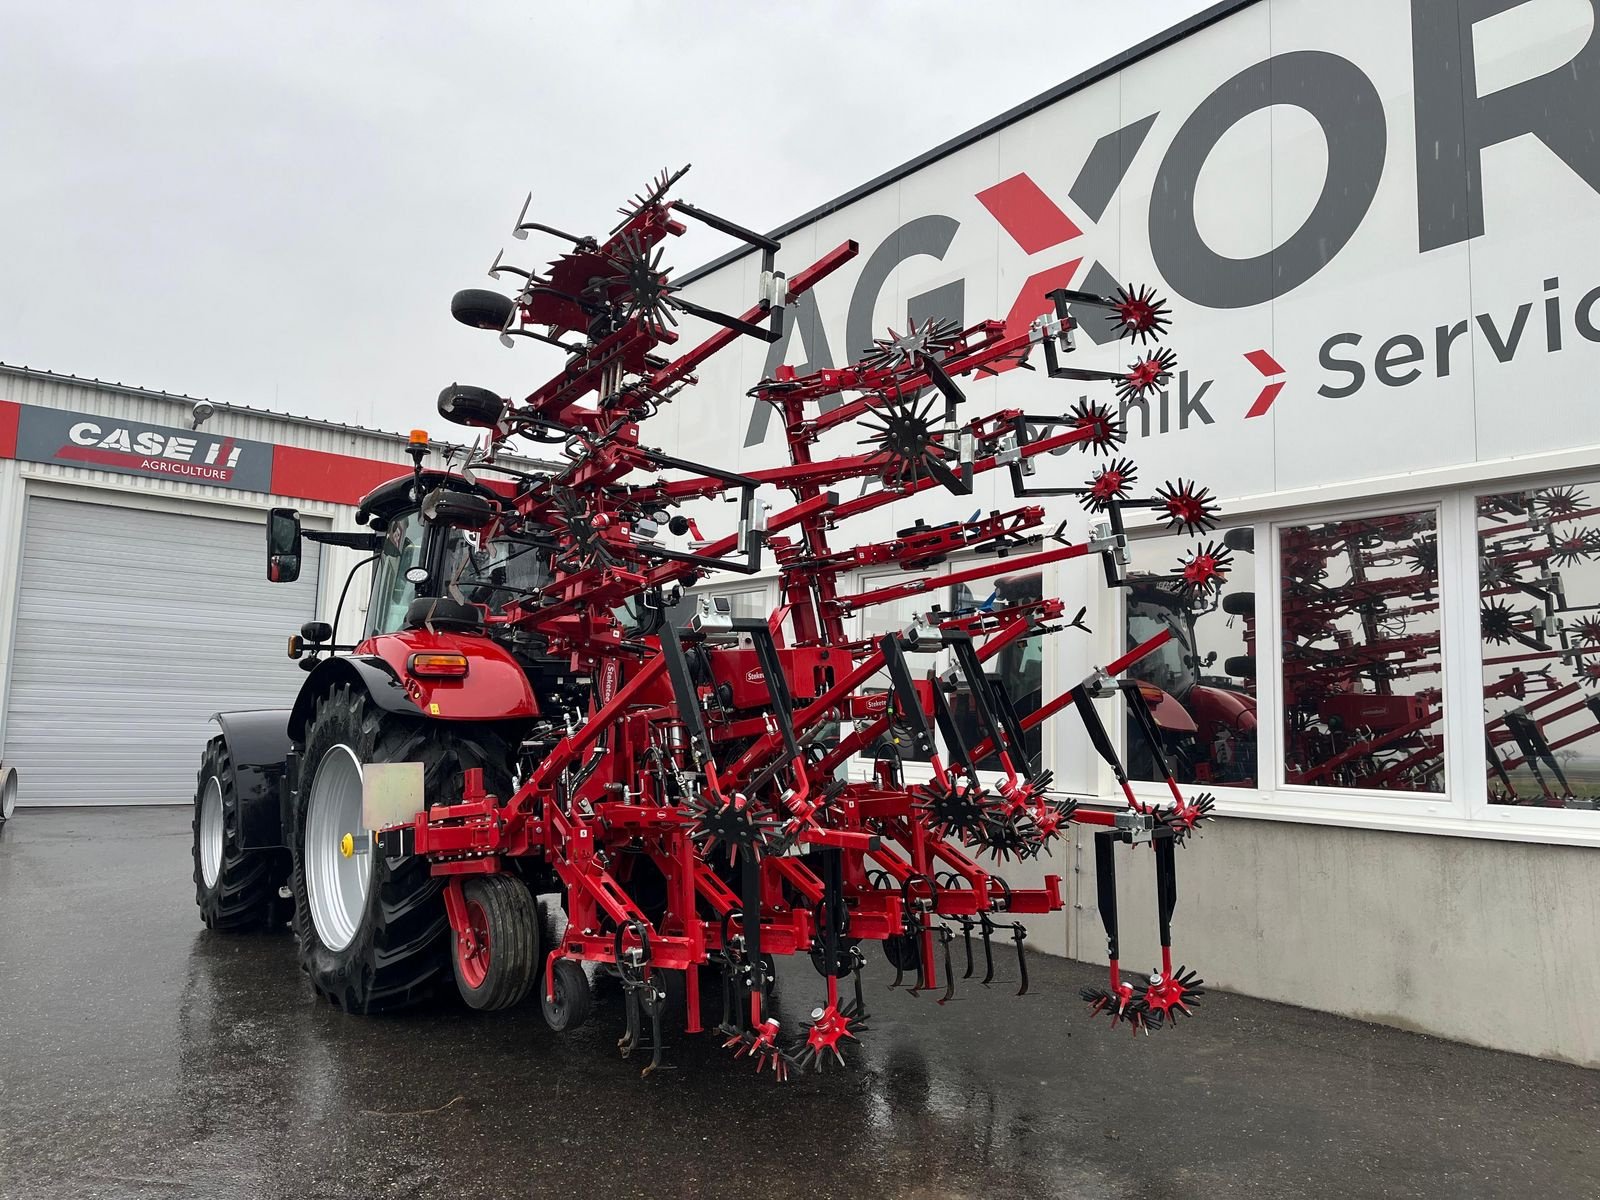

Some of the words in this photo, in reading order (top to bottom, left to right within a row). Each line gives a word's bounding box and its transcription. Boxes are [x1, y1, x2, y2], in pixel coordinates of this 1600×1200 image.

[69, 422, 198, 461] CASE
[141, 459, 227, 480] AGRICULTURE
[605, 666, 614, 702] Steketee
[747, 672, 765, 681] Steke
[868, 700, 887, 708] Stekete
